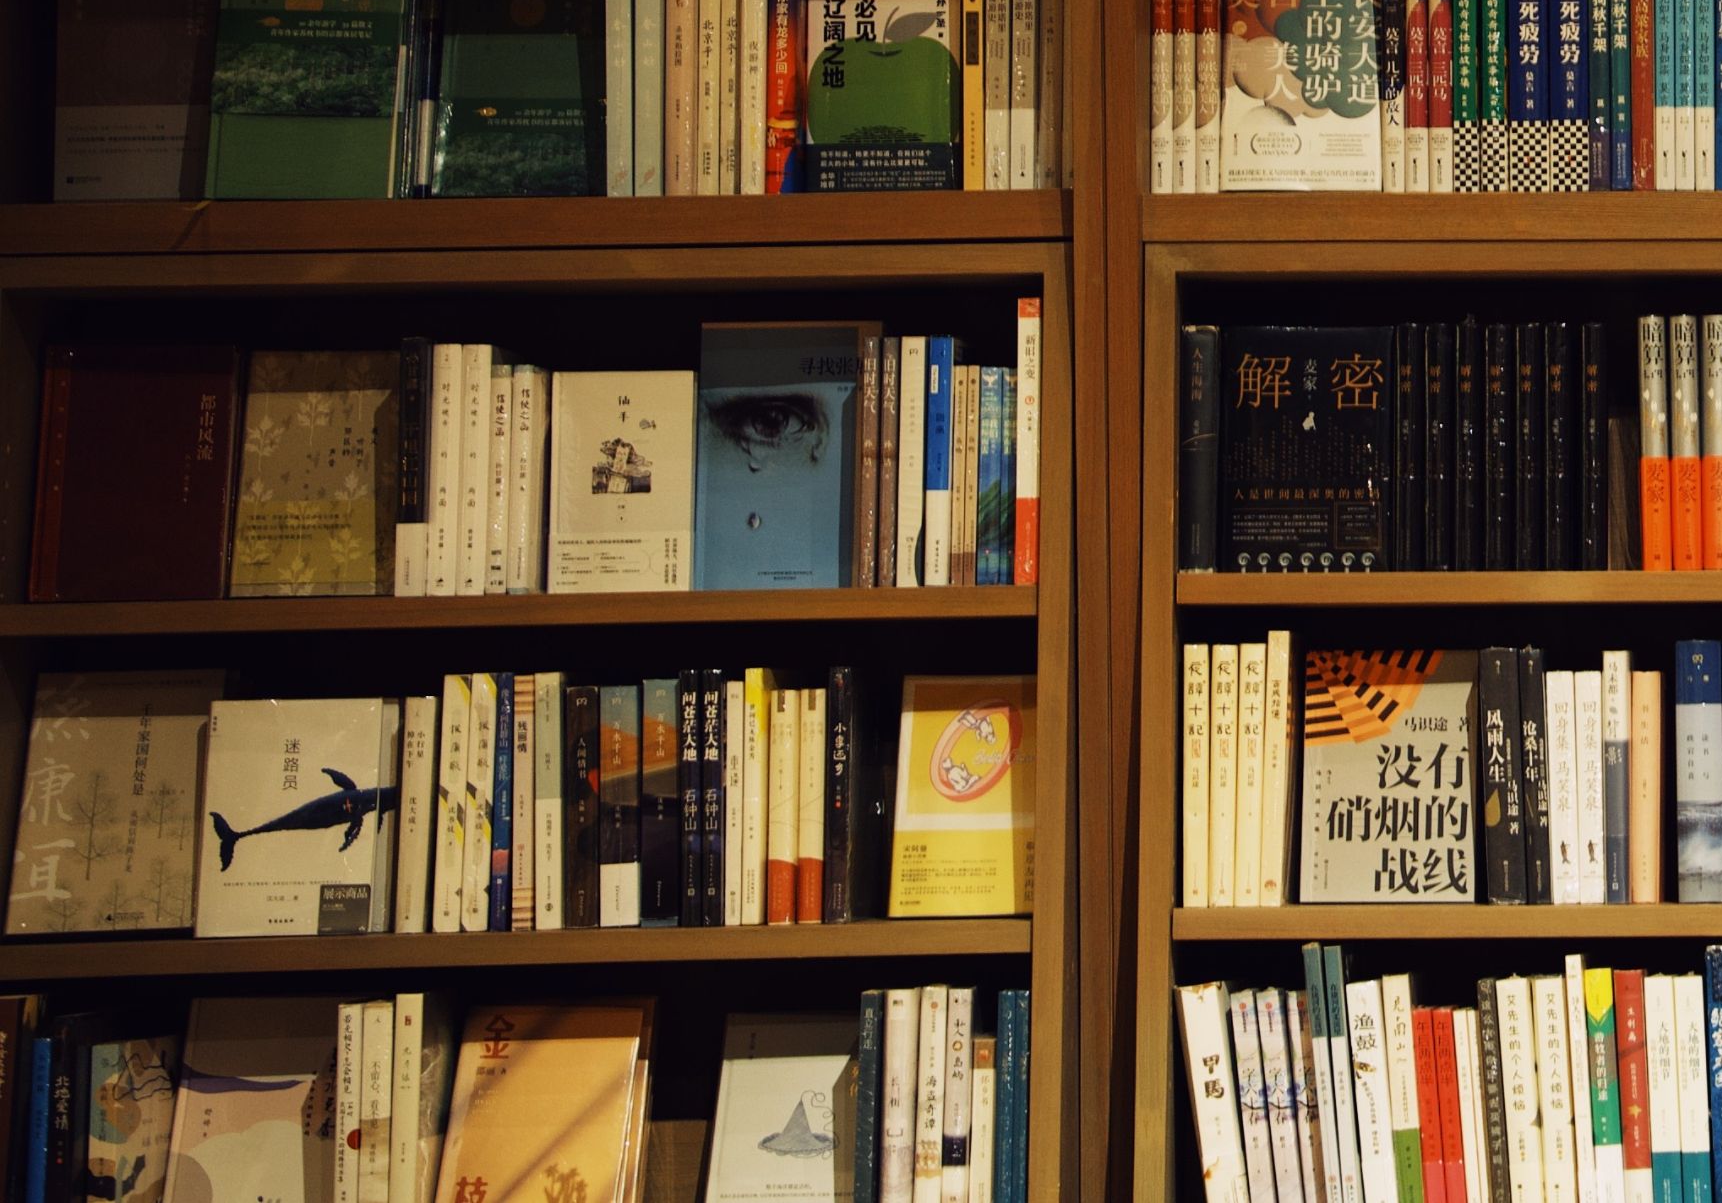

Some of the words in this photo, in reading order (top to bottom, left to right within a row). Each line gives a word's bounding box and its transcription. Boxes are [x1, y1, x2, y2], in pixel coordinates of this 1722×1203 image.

[1266, 38, 1300, 103] 美人
[1385, 61, 1400, 126] 儿子的敌人
[1408, 61, 1425, 101] 三匹马
[863, 356, 877, 415] 旧时天气
[883, 356, 897, 415] 旧时天气
[1234, 352, 1292, 412] 解
[1330, 352, 1385, 411] 密
[1303, 358, 1317, 392] 麦家
[198, 394, 216, 461] 都市风流
[611, 720, 623, 766] 万水千山
[681, 691, 698, 761] 问苍茫大地
[702, 691, 719, 761] 问苍茫大地
[1404, 716, 1448, 732] 马识途
[1458, 716, 1471, 732] 著
[1486, 710, 1506, 784] 风雨人生
[1554, 701, 1569, 749] 回身集
[283, 738, 300, 792] 迷路员
[577, 737, 588, 781] 人间情书
[1376, 742, 1468, 790] 没有
[1523, 720, 1538, 784] 沧桑十年
[684, 788, 698, 831] 石钟山
[705, 788, 719, 831] 石钟山
[1555, 760, 1569, 811] 马笑泉
[1326, 795, 1469, 843] 硝烟的
[1374, 848, 1468, 894] 战线
[480, 1013, 514, 1060] 金
[1353, 1014, 1377, 1051] 渔鼓
[1507, 994, 1527, 1113] 艾先生的个人烦恼
[1544, 993, 1564, 1112] 艾先生的个人烦恼
